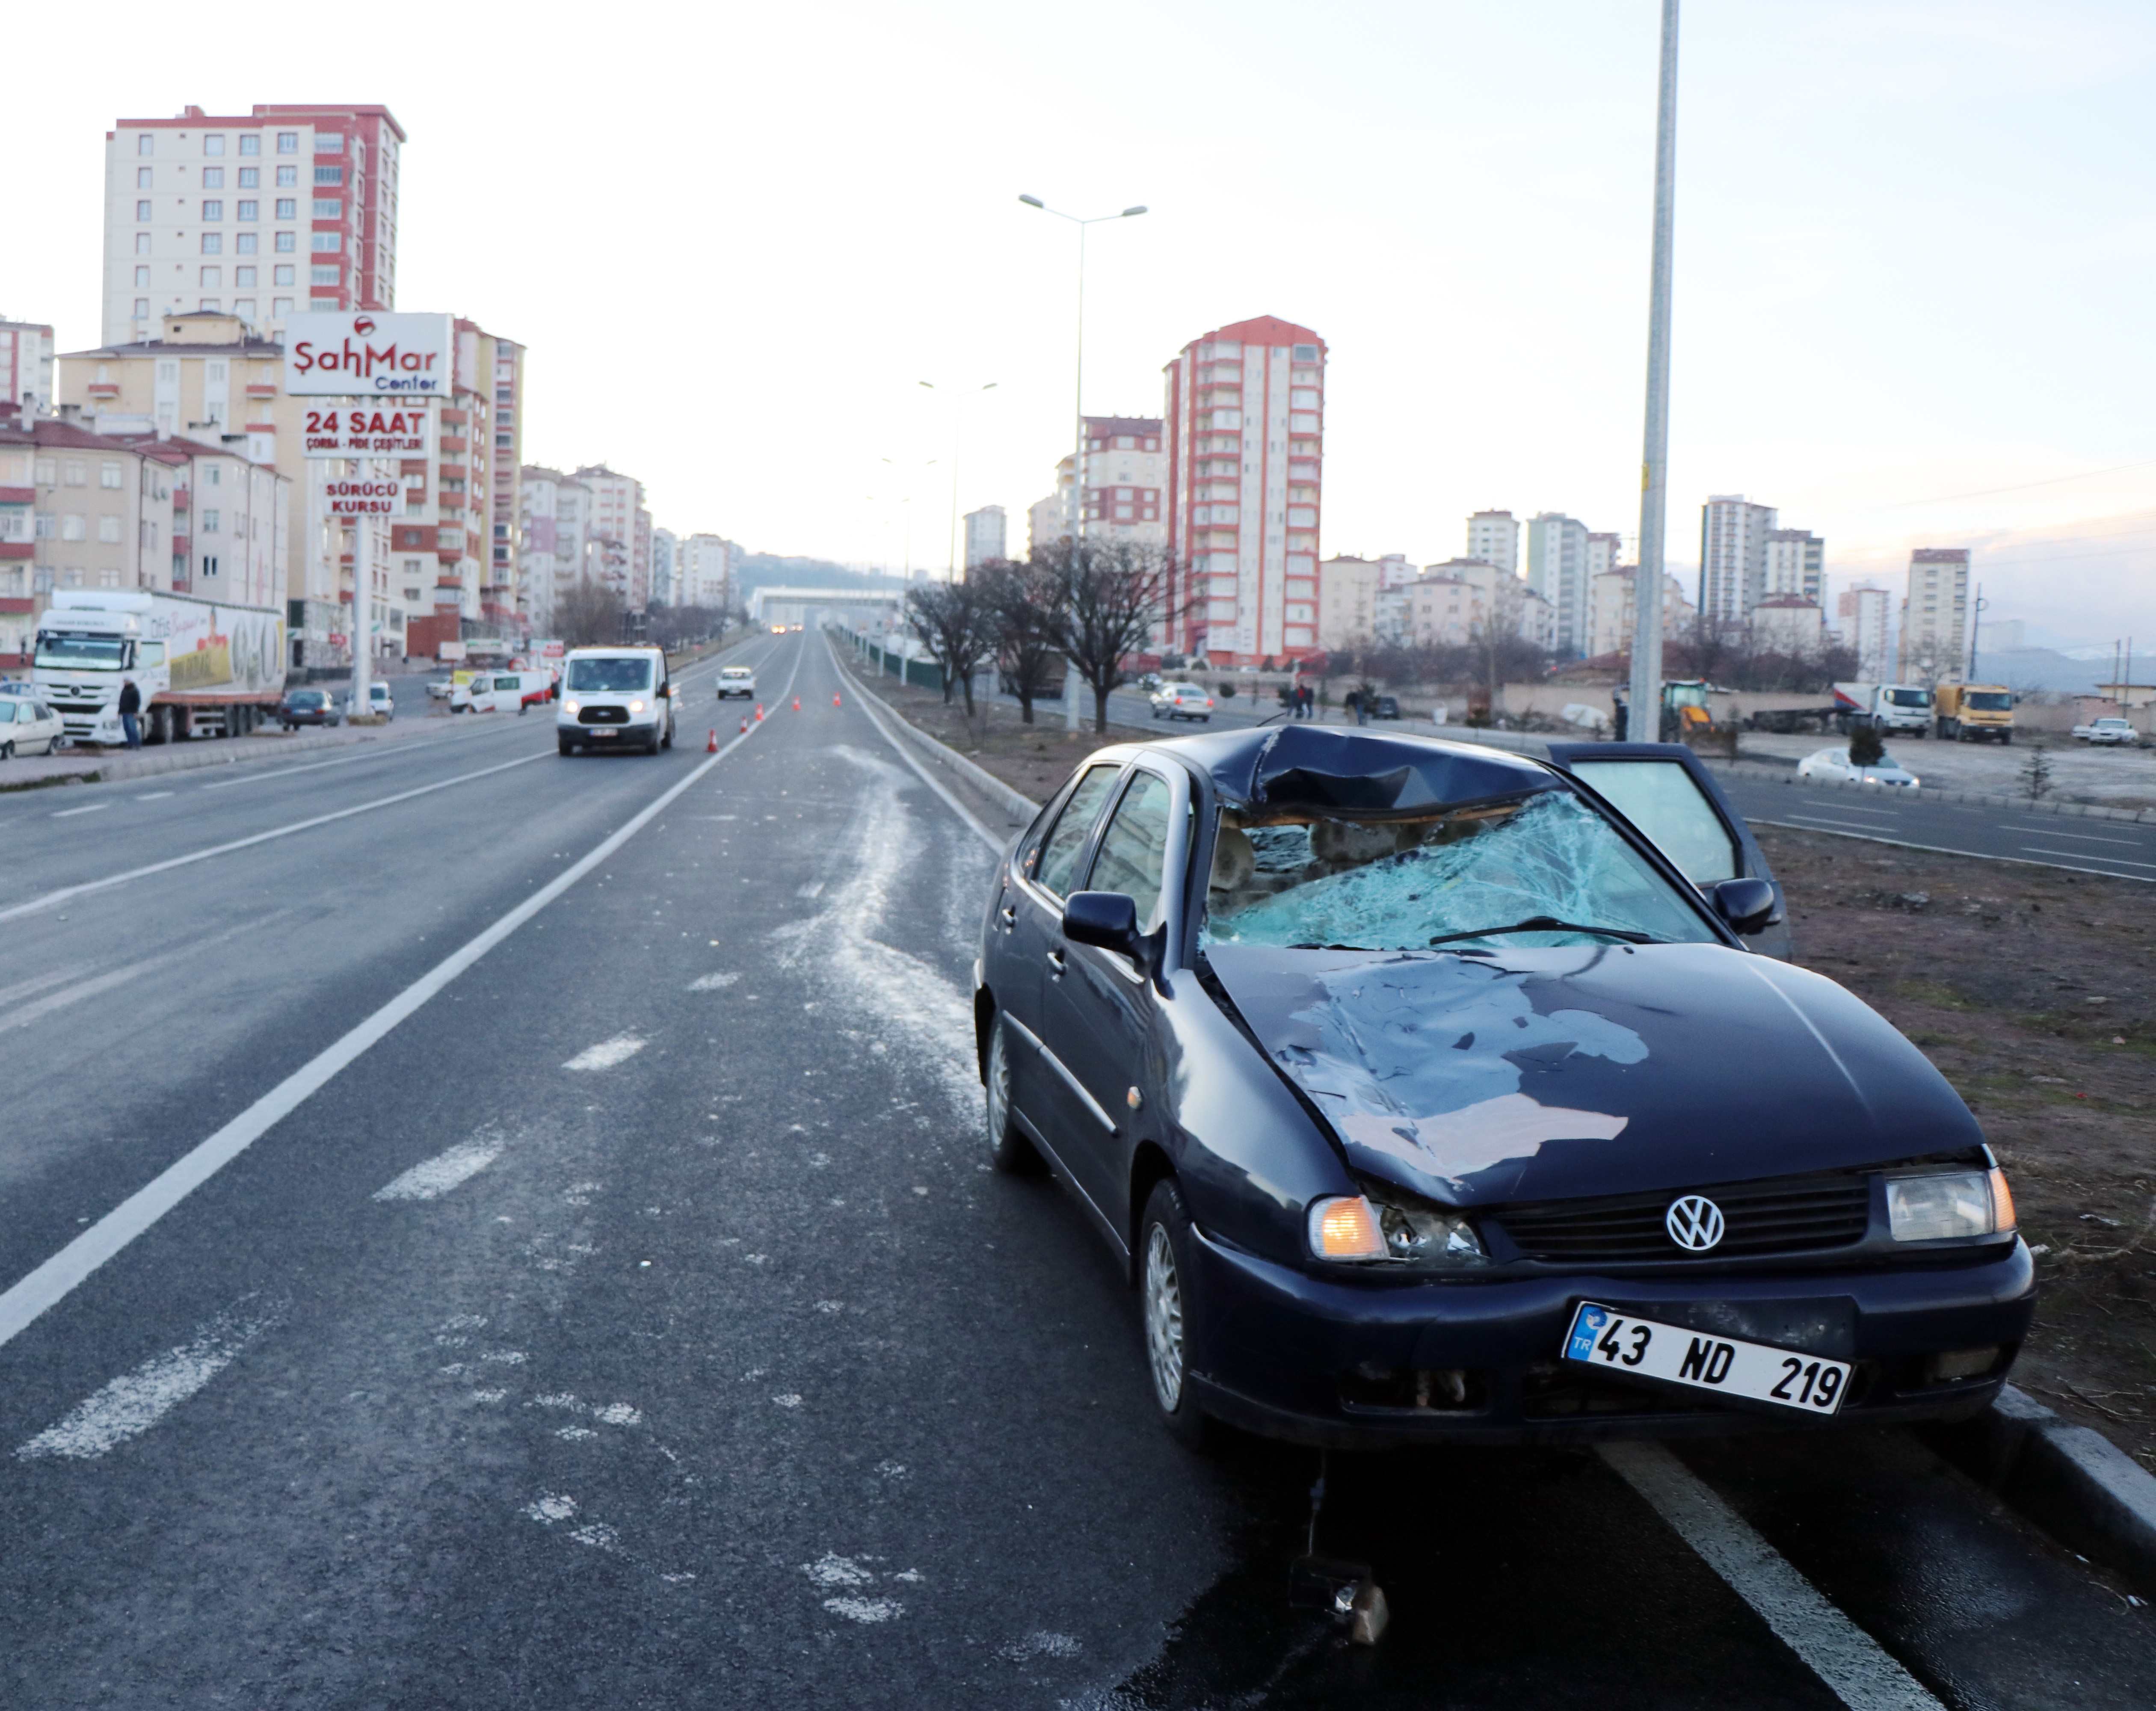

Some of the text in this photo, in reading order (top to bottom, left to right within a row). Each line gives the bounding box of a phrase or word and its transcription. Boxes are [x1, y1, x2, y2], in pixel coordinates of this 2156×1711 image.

[306, 411, 424, 434] 24 SAAT
[326, 482, 398, 496] SÜRÜCÜ
[332, 500, 392, 512] KURSU
[1574, 1319, 1842, 1407] TR 43 ND 219
